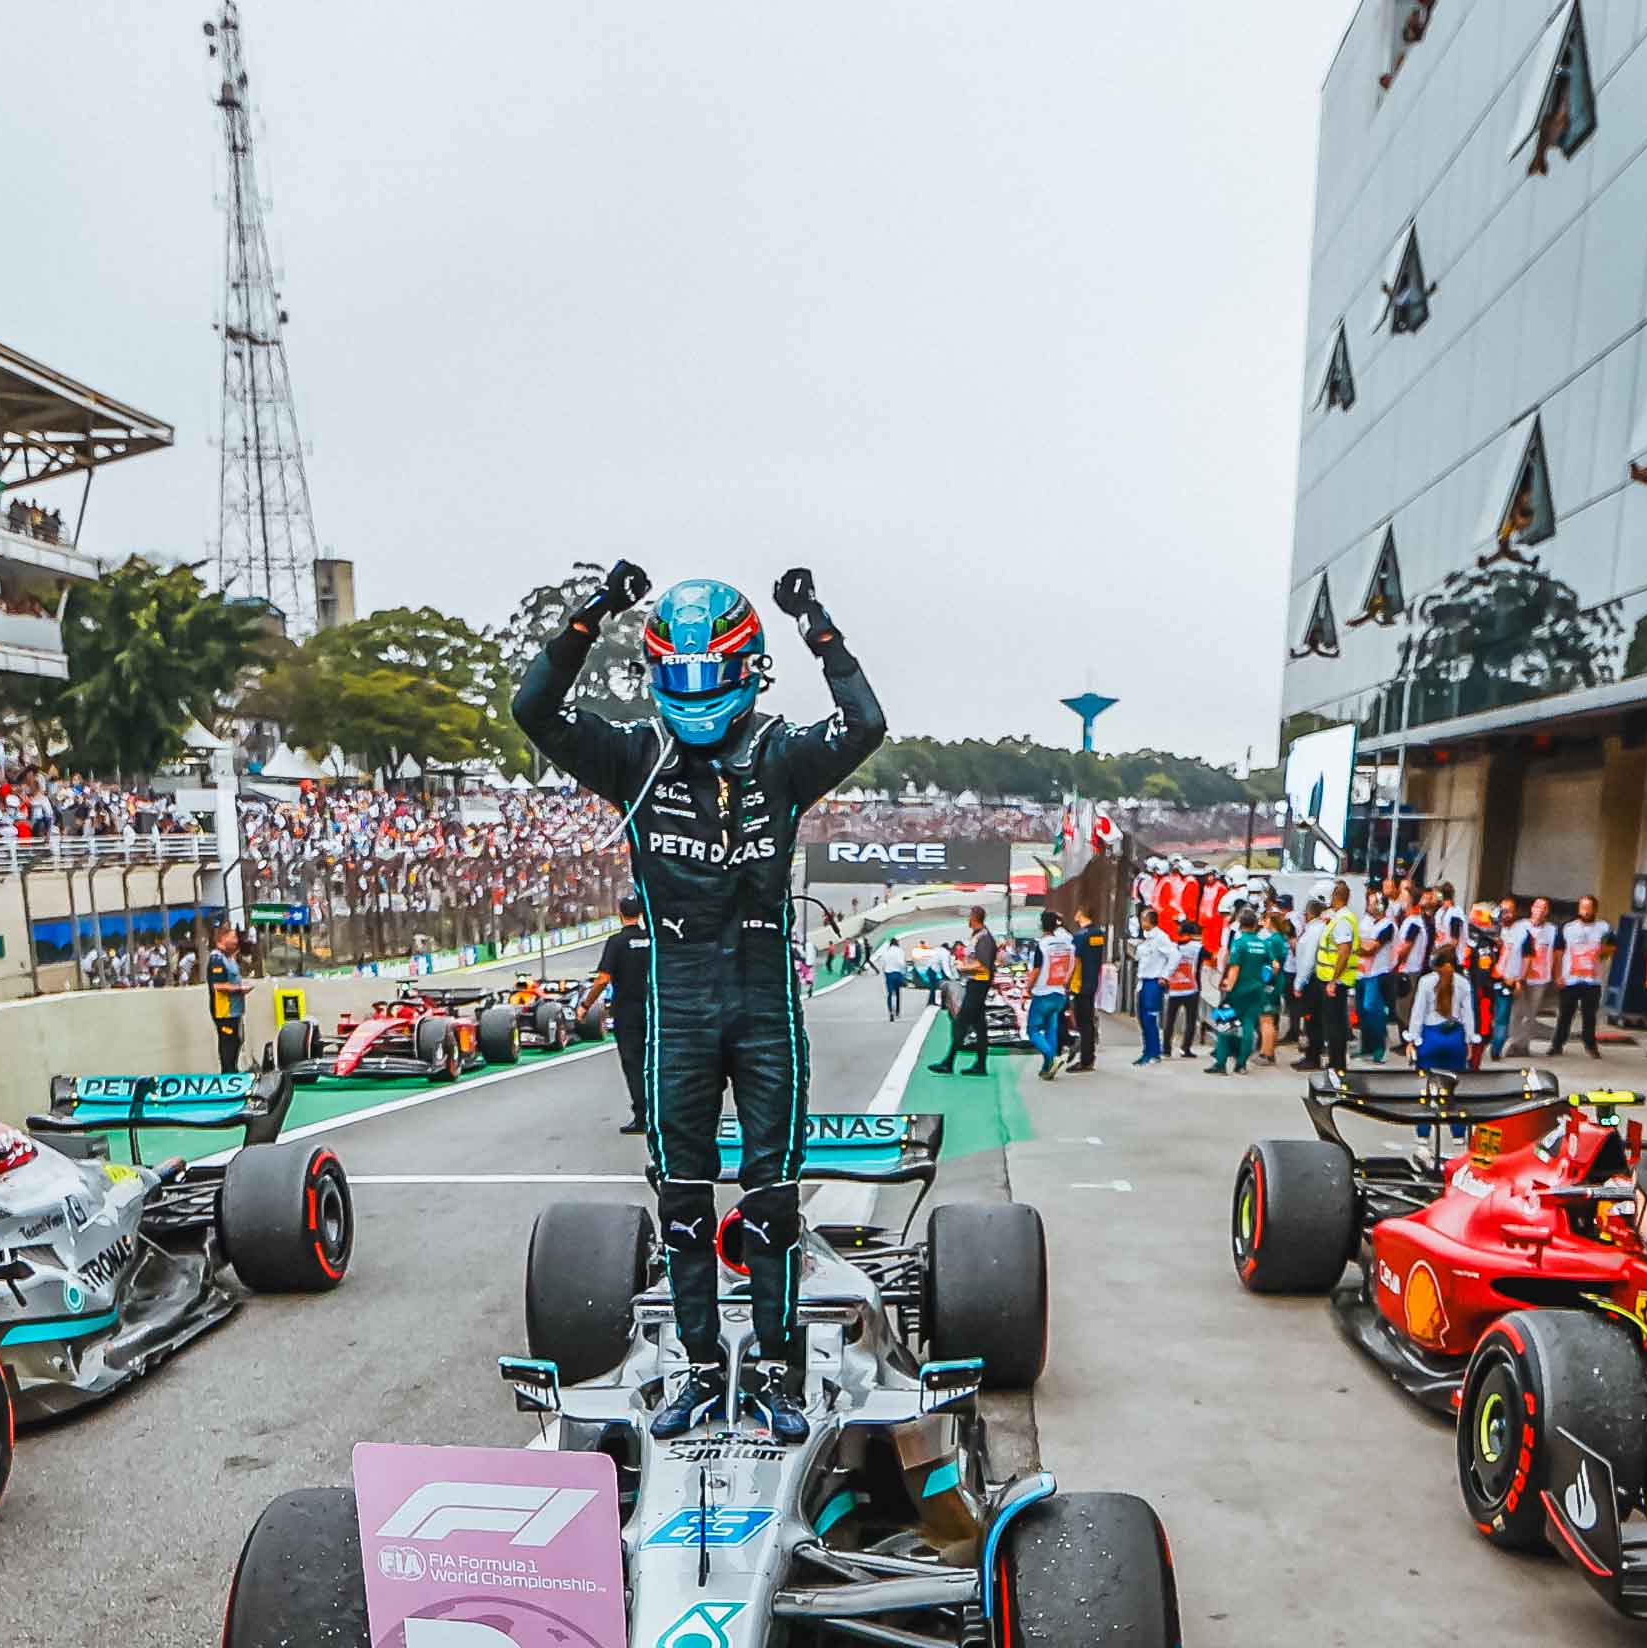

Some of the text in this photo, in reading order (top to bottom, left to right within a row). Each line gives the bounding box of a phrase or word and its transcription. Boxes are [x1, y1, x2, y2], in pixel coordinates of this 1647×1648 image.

[661, 653, 723, 665] PETRONAS
[828, 842, 946, 863] RACE
[84, 1078, 243, 1097] PETONAS
[670, 1439, 781, 1447] PETRONA
[664, 1447, 787, 1463] Syntium
[375, 1482, 600, 1547] F1
[380, 1551, 422, 1575] FIA
[429, 1553, 538, 1573] FIA Formula 1
[431, 1568, 597, 1594] World Championship
